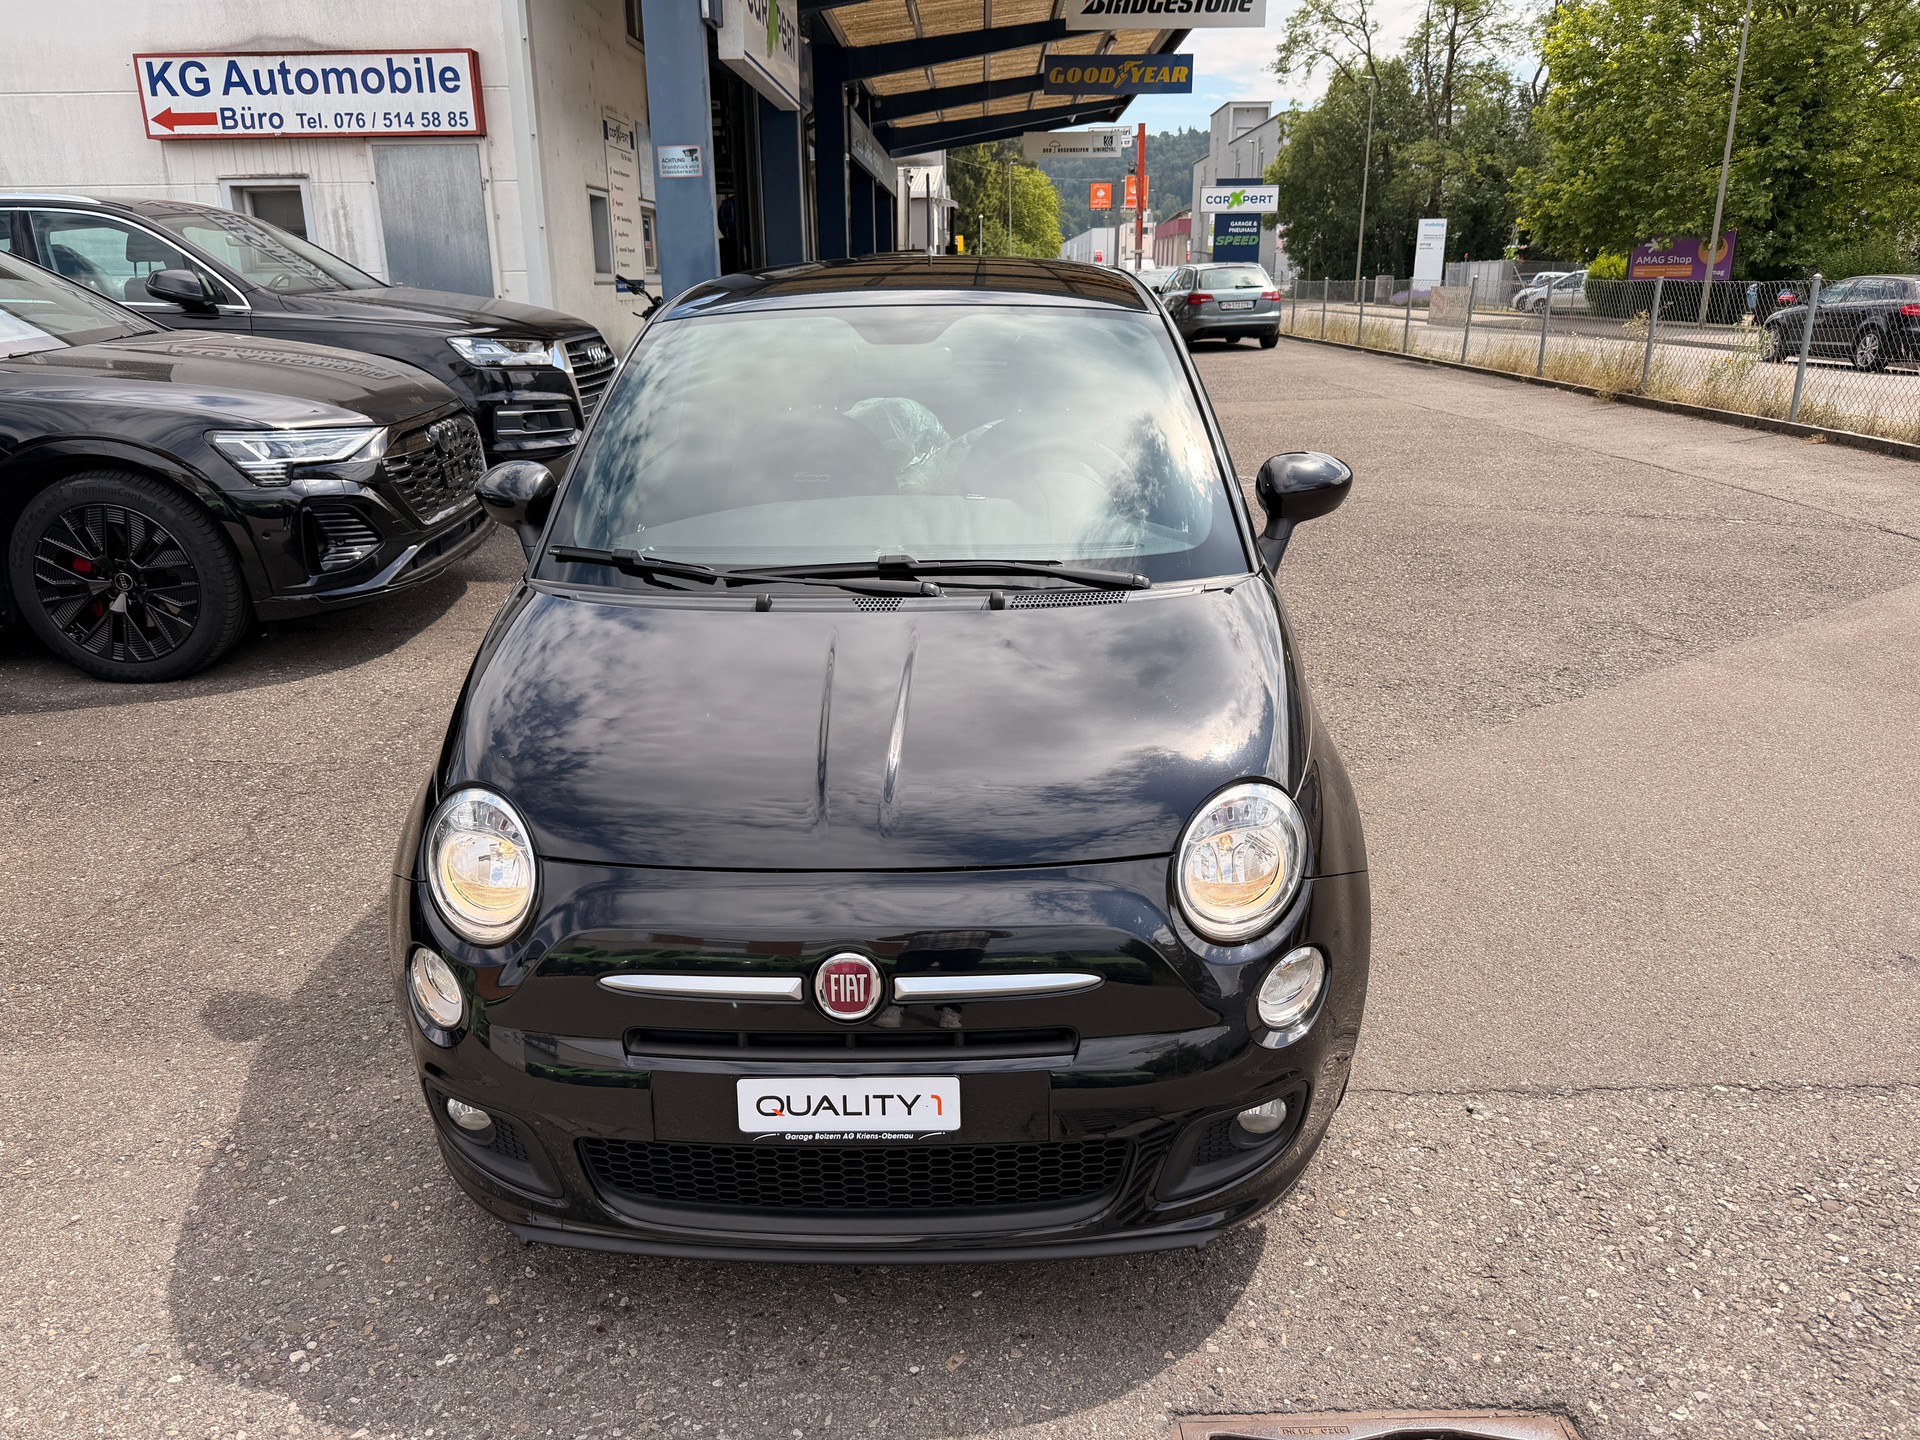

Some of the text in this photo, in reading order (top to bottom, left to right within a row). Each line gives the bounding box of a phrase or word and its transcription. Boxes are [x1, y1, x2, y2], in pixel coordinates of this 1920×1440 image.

[145, 56, 461, 98] KG Automobile
[218, 107, 469, 131] Büro Tel. 076 / 514 58 85
[1215, 235, 1259, 246] SPEED
[1635, 256, 1692, 265] AMAG Shop
[830, 974, 868, 1002] FIAT
[755, 1094, 922, 1117] QUALITY
[784, 1131, 914, 1141] Garage Bolzern AG Kriens-Obernau
